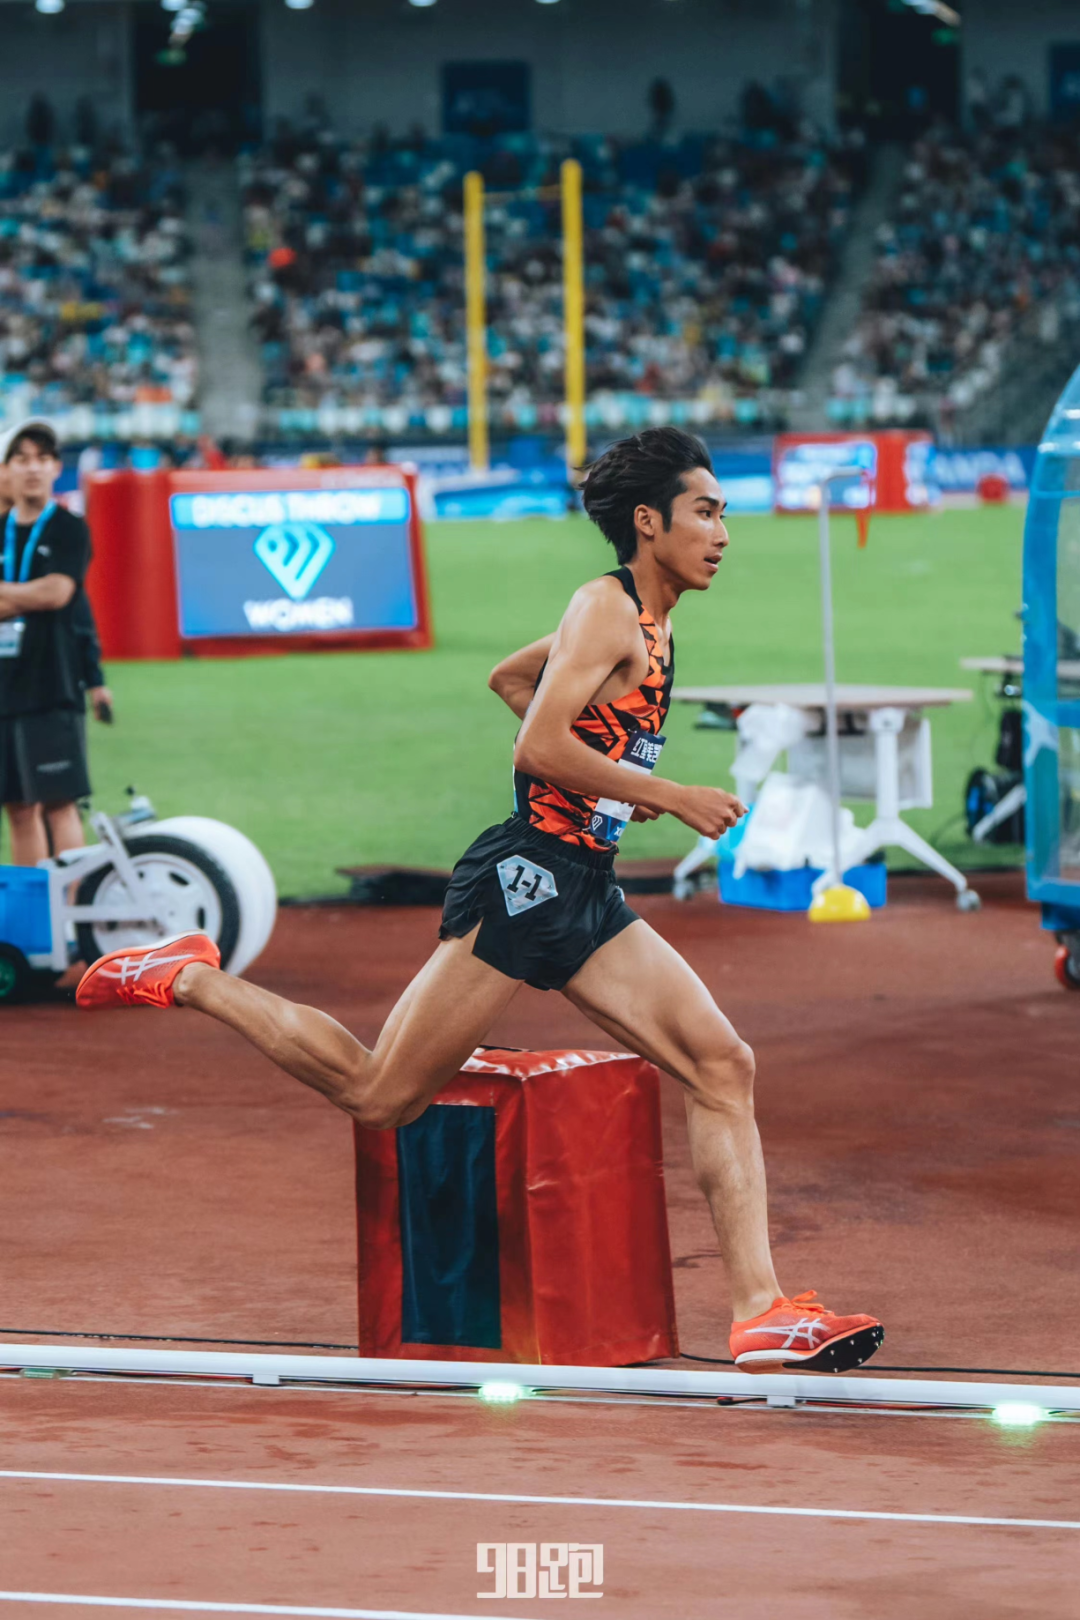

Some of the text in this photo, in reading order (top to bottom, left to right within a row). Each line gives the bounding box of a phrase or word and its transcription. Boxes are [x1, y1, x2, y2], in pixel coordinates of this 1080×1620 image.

[286, 491, 381, 525] THROW
[243, 597, 354, 631] WOMEN
[506, 865, 543, 901] 1-1
